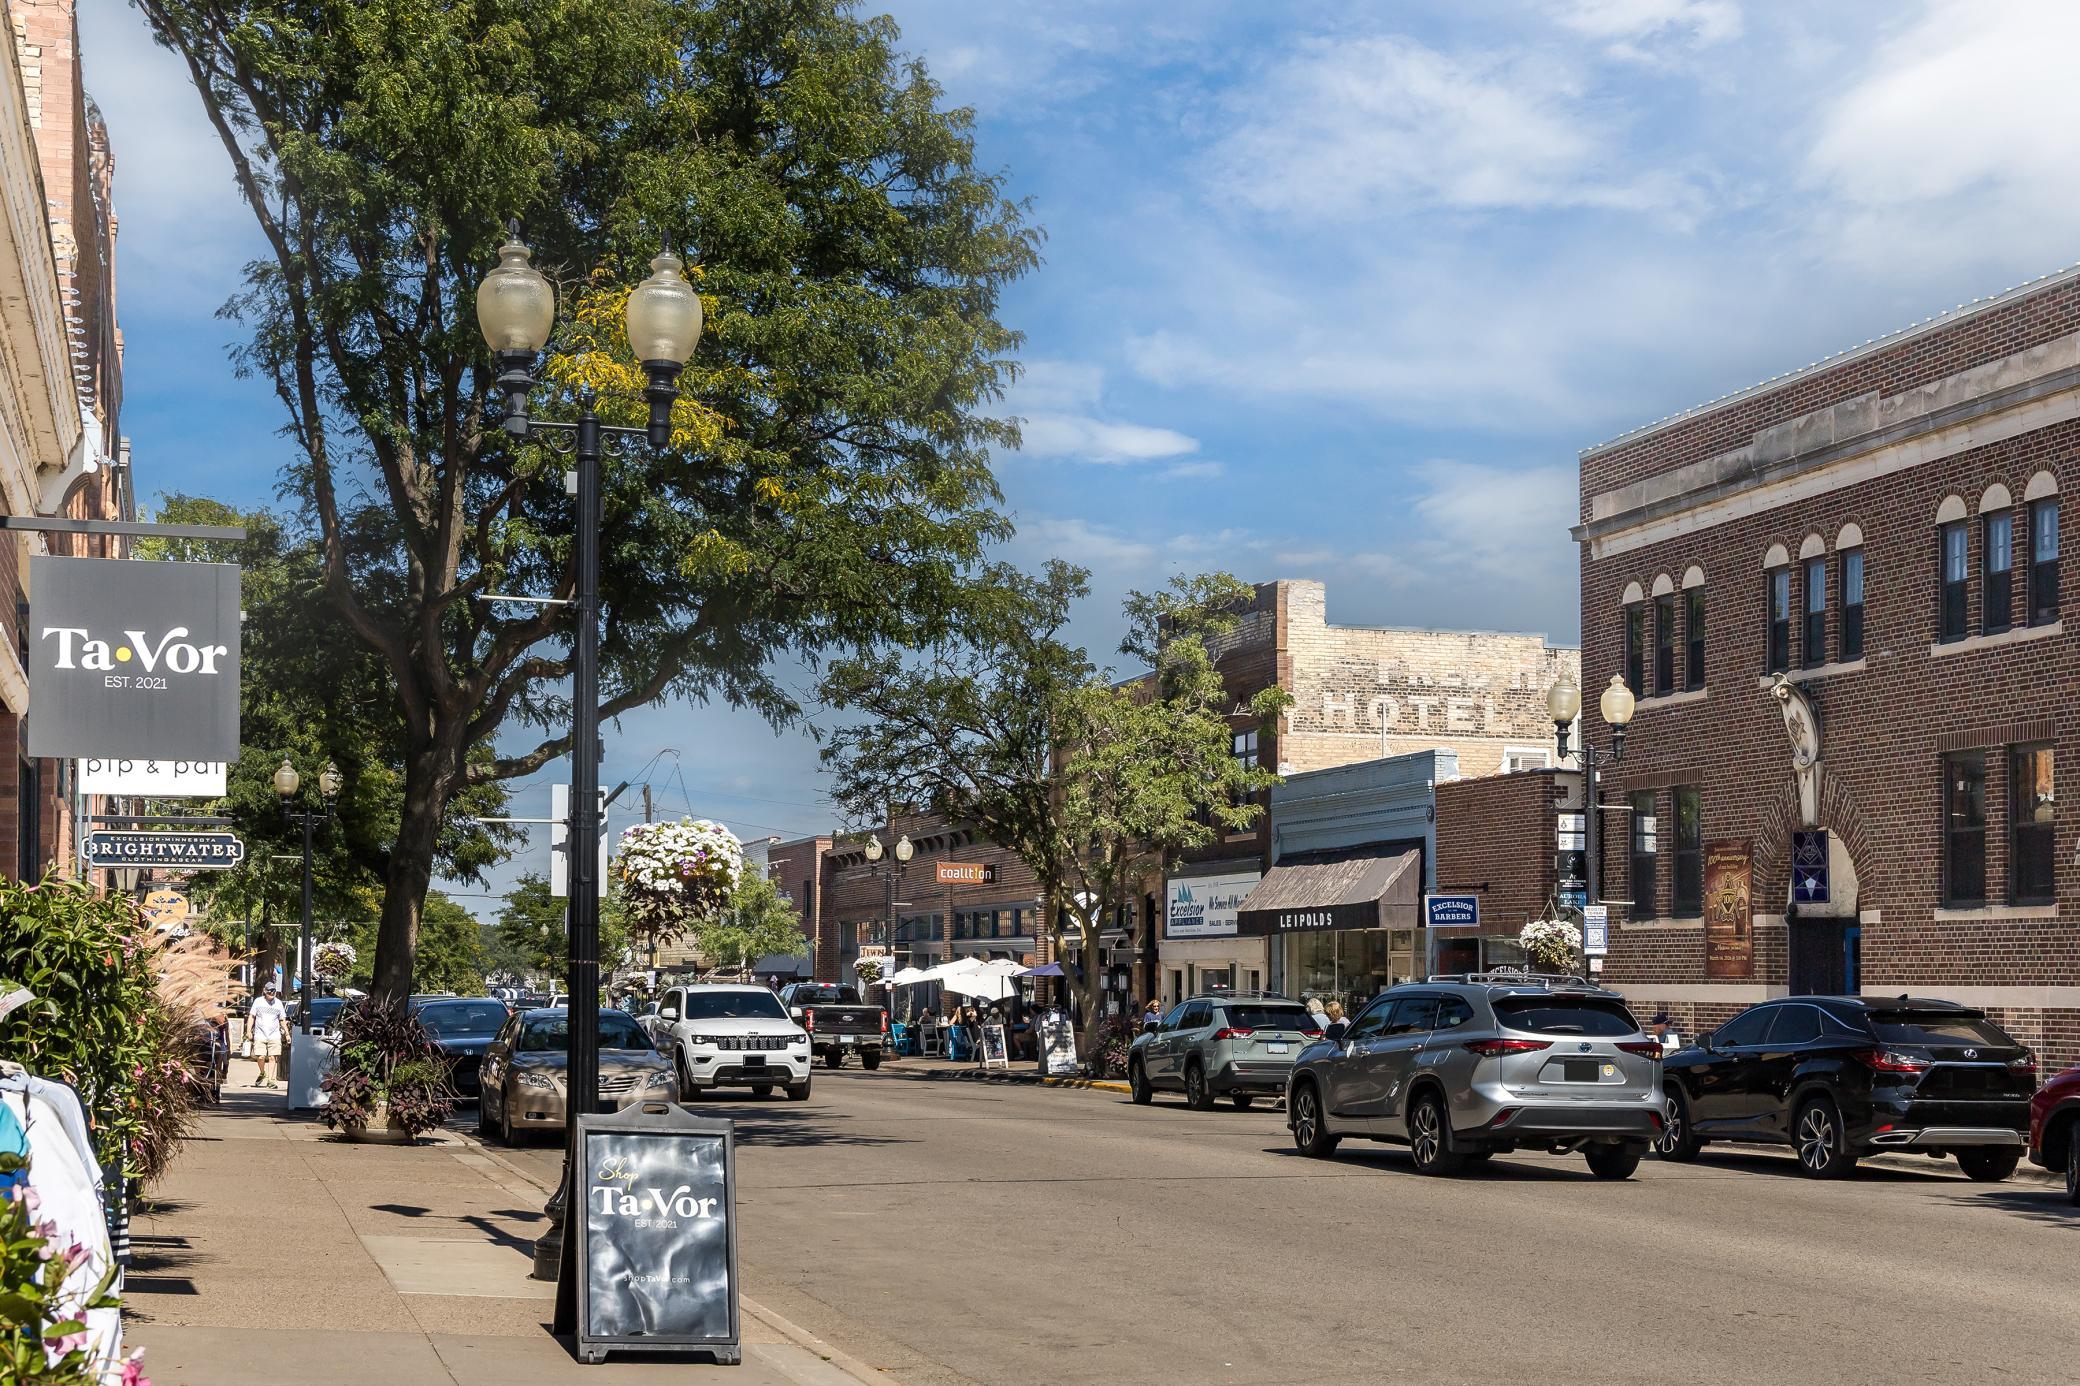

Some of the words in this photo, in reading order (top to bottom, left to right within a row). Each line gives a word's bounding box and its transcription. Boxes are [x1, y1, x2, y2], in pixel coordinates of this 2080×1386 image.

[104, 675, 132, 689] EST.
[135, 676, 167, 690] 2021
[1323, 691, 1506, 734] HOTEL
[146, 760, 160, 774] &
[86, 842, 239, 858] BRIGHTWATER
[940, 867, 992, 880] coalition
[1169, 899, 1205, 918] Excelsior
[1431, 901, 1474, 913] EXCELSIOR
[1280, 912, 1333, 928] LEIPOLDS
[1434, 913, 1472, 921] BARBERS
[598, 1157, 639, 1191] Shop
[655, 1220, 678, 1229] 2021
